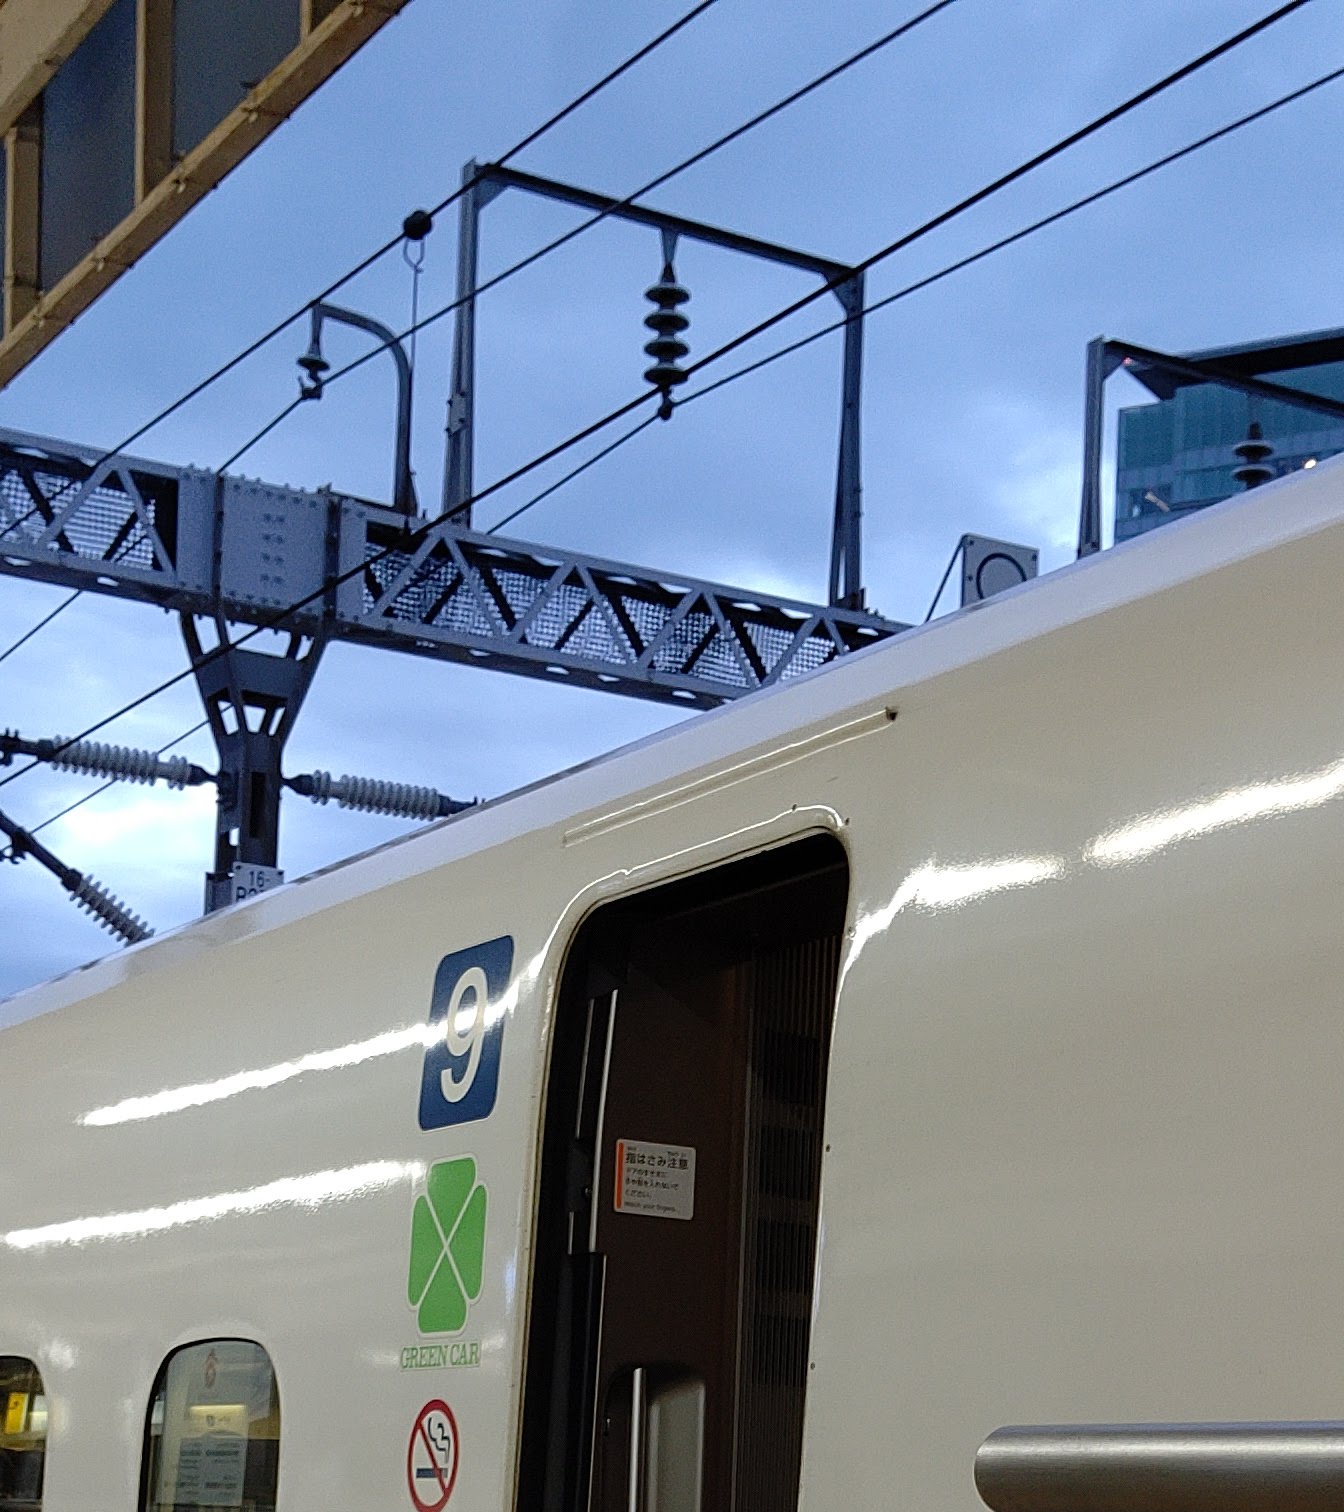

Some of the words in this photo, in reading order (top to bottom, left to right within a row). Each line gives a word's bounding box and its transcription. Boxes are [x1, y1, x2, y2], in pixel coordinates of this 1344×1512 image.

[440, 966, 489, 1104] 9
[399, 1344, 448, 1369] GREEN
[451, 1342, 480, 1366] CAR
